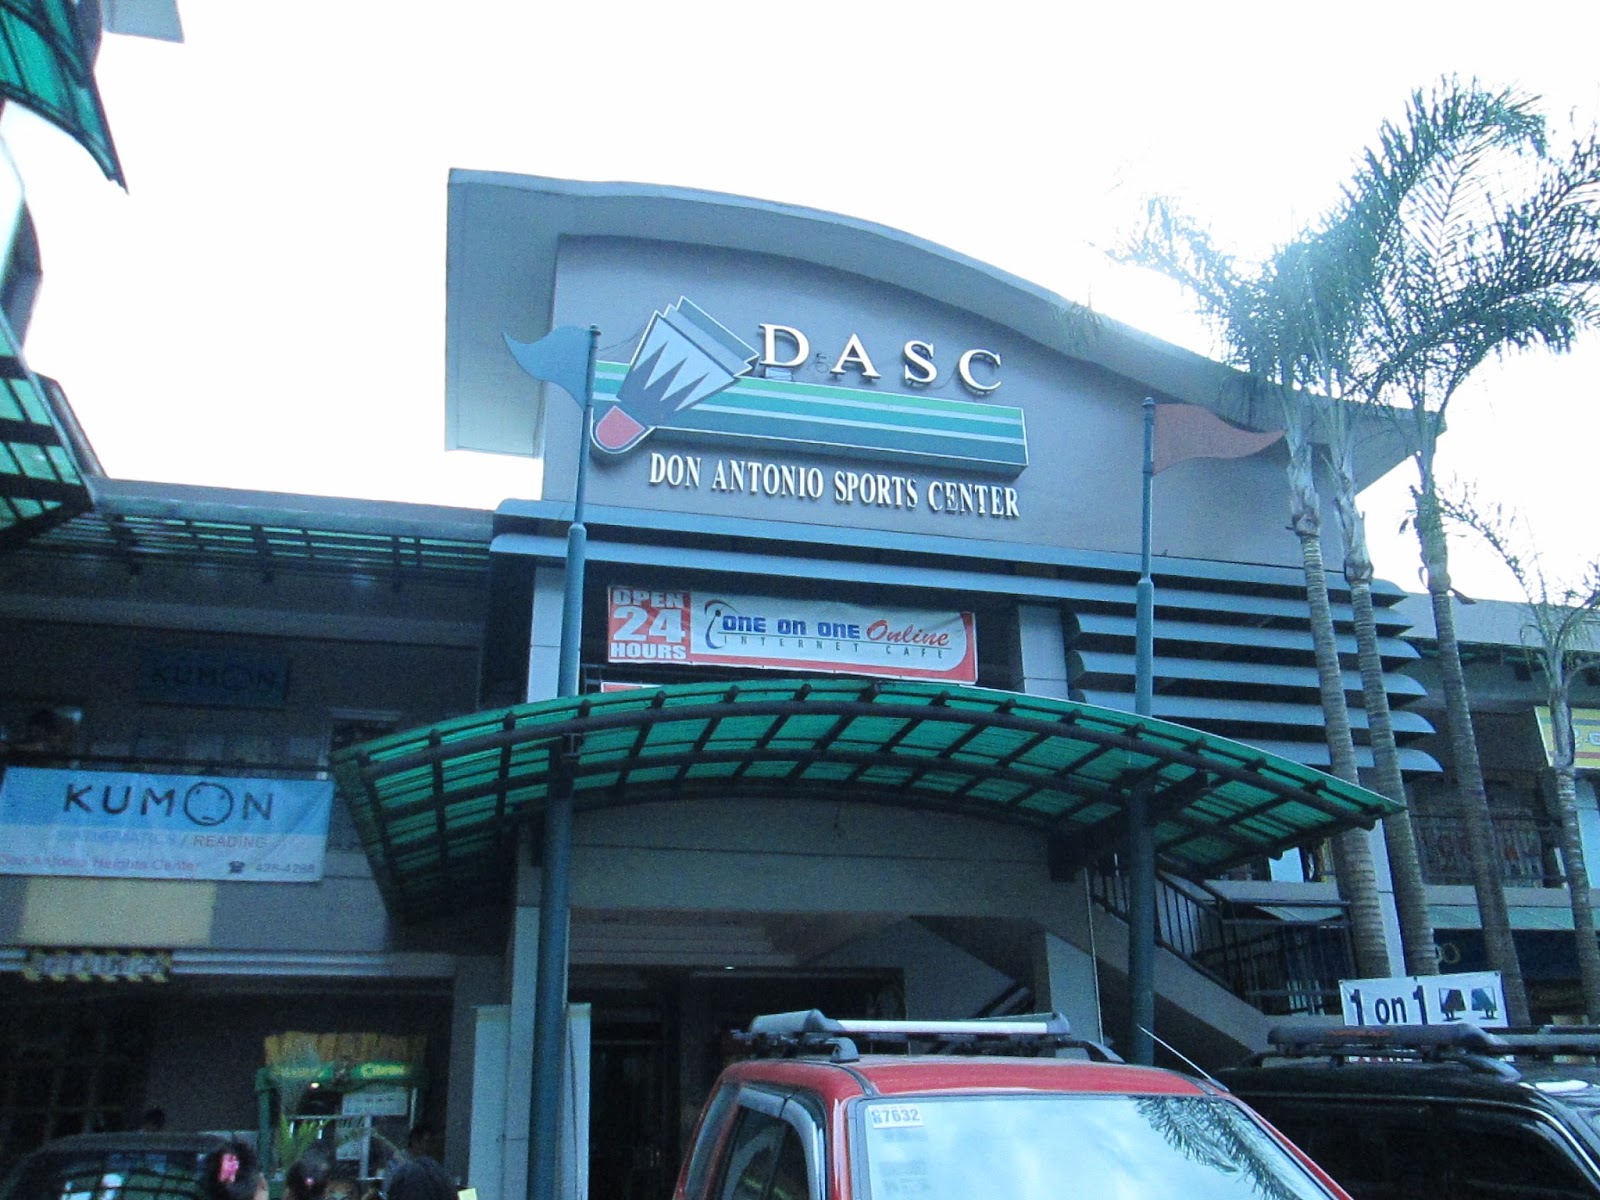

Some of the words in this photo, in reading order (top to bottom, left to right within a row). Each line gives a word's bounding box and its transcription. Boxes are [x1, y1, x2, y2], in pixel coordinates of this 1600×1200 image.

[760, 323, 1002, 393] DASC
[649, 453, 701, 487] DON
[711, 461, 824, 500] ANTONIO
[834, 471, 919, 510] SPORTS
[928, 482, 1021, 518] CENTER
[613, 589, 685, 608] OPEN
[613, 605, 686, 643] 24
[866, 619, 950, 647] Online
[610, 642, 687, 660] HOURS
[724, 635, 859, 652] INTERNET
[886, 645, 943, 659] CAFE
[150, 662, 278, 692] KUMON
[62, 782, 274, 827] KUMON
[193, 834, 267, 849] READING
[1375, 996, 1408, 1025] on
